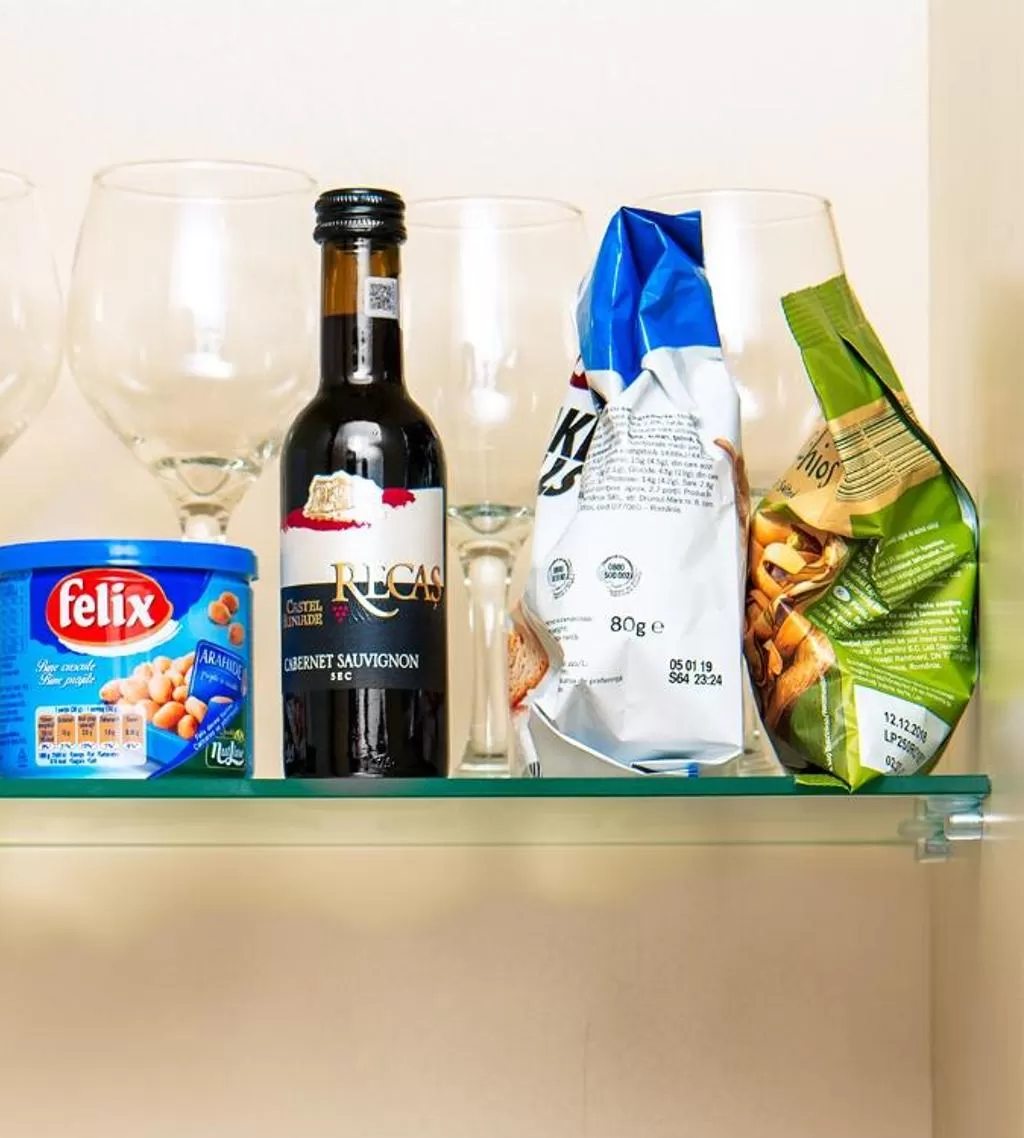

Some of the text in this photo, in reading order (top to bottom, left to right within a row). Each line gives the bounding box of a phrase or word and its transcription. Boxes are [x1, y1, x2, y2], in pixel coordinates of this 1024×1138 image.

[59, 577, 155, 628] felix
[284, 652, 420, 671] CABERNET SAUVIGNON
[670, 659, 713, 673] 05 01 19
[330, 671, 353, 681] SEC
